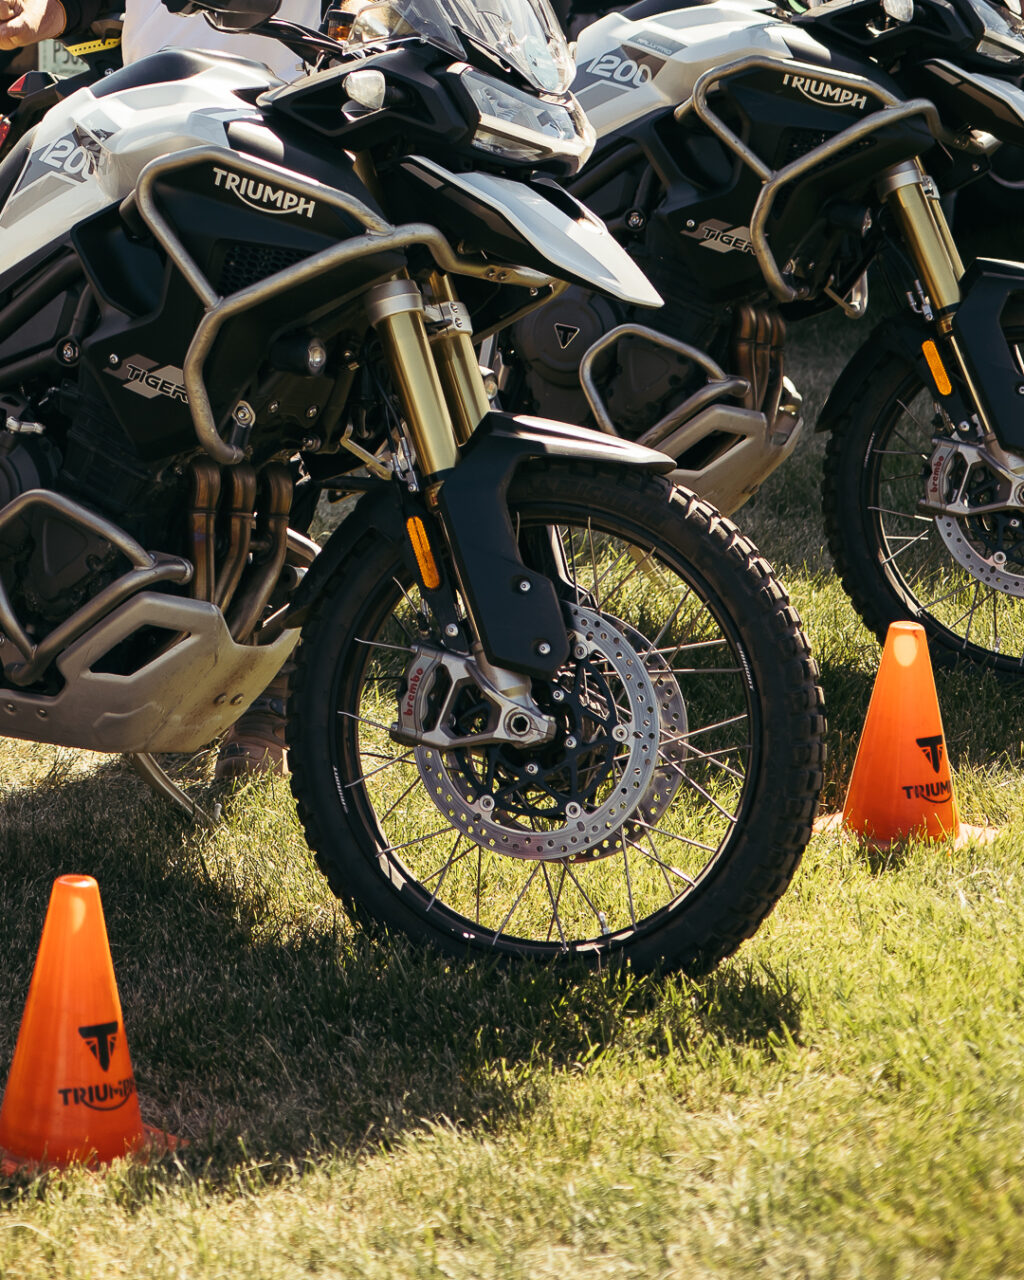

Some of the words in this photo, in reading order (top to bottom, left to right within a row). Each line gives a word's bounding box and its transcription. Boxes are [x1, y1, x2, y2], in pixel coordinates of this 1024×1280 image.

[585, 53, 652, 87] 1200
[212, 167, 316, 218] TRIUMPH
[929, 455, 945, 493] brembo
[402, 667, 424, 717] brembo
